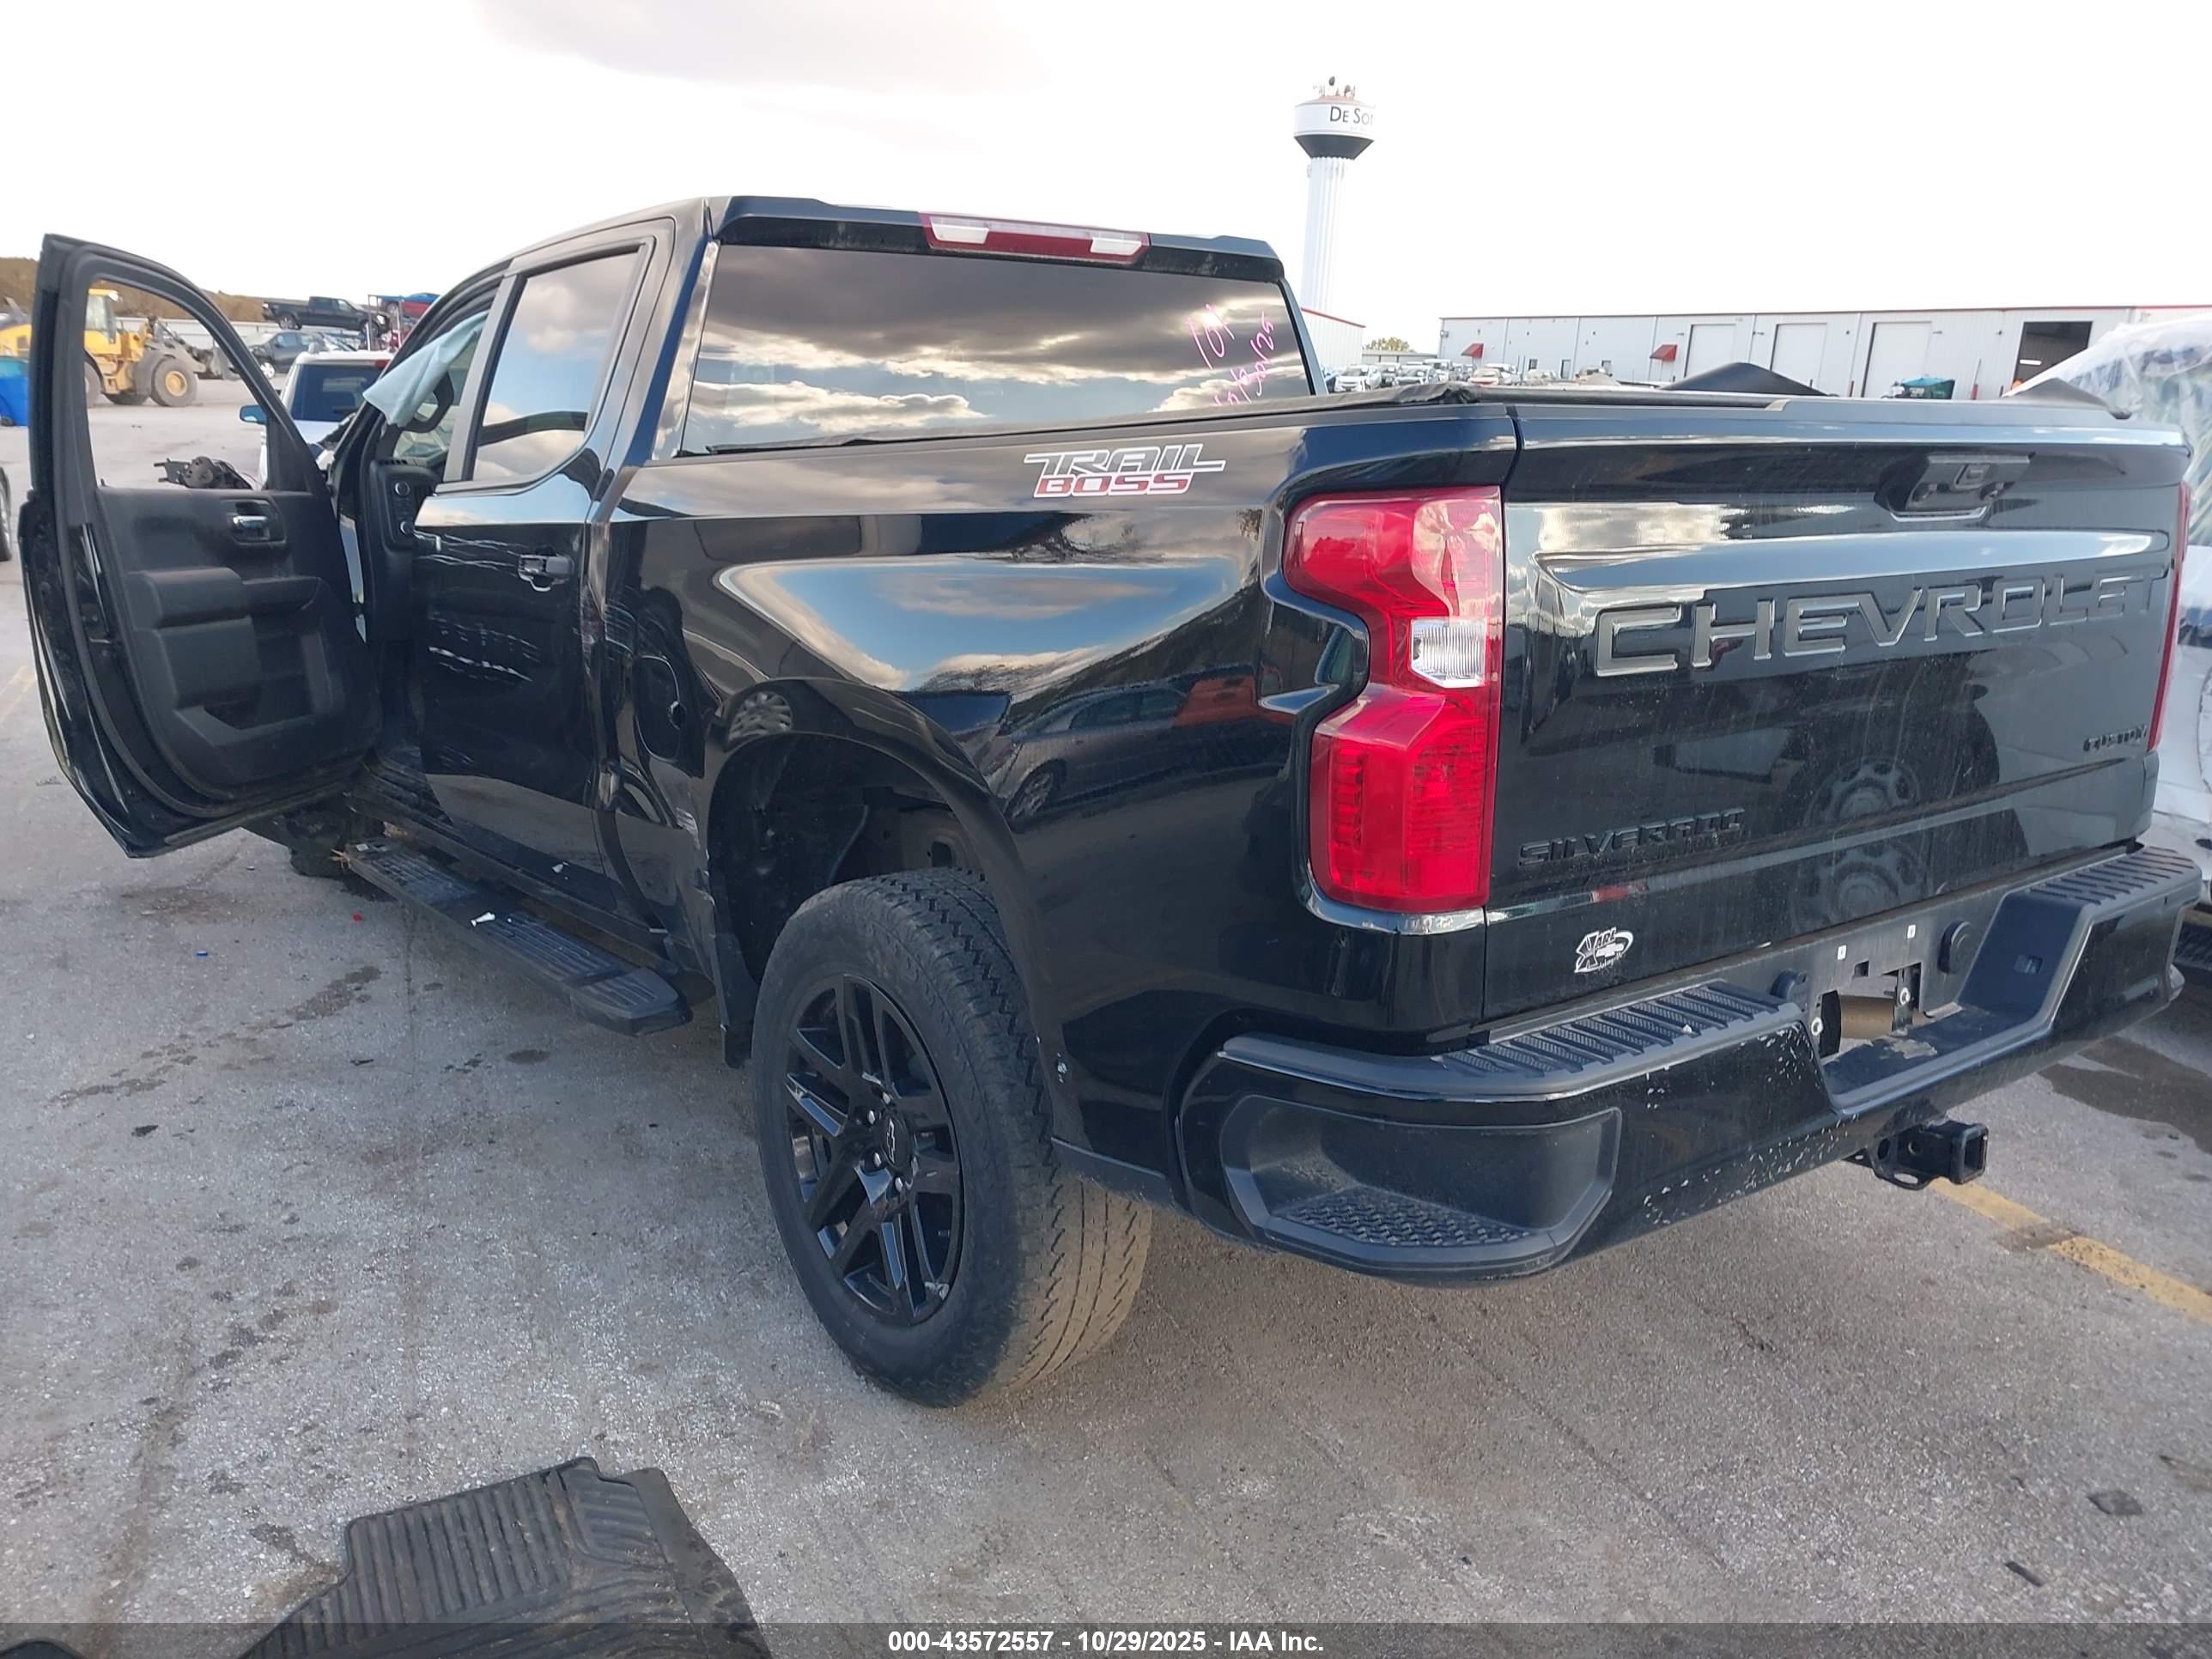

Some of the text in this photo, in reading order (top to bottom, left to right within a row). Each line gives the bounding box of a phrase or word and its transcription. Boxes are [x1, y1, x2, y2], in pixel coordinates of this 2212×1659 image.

[1024, 443, 1227, 477] TRAIL
[1033, 471, 1194, 498] BOSS
[1595, 563, 2170, 677] CHEVROLET
[1518, 807, 1746, 866] SILVERADO
